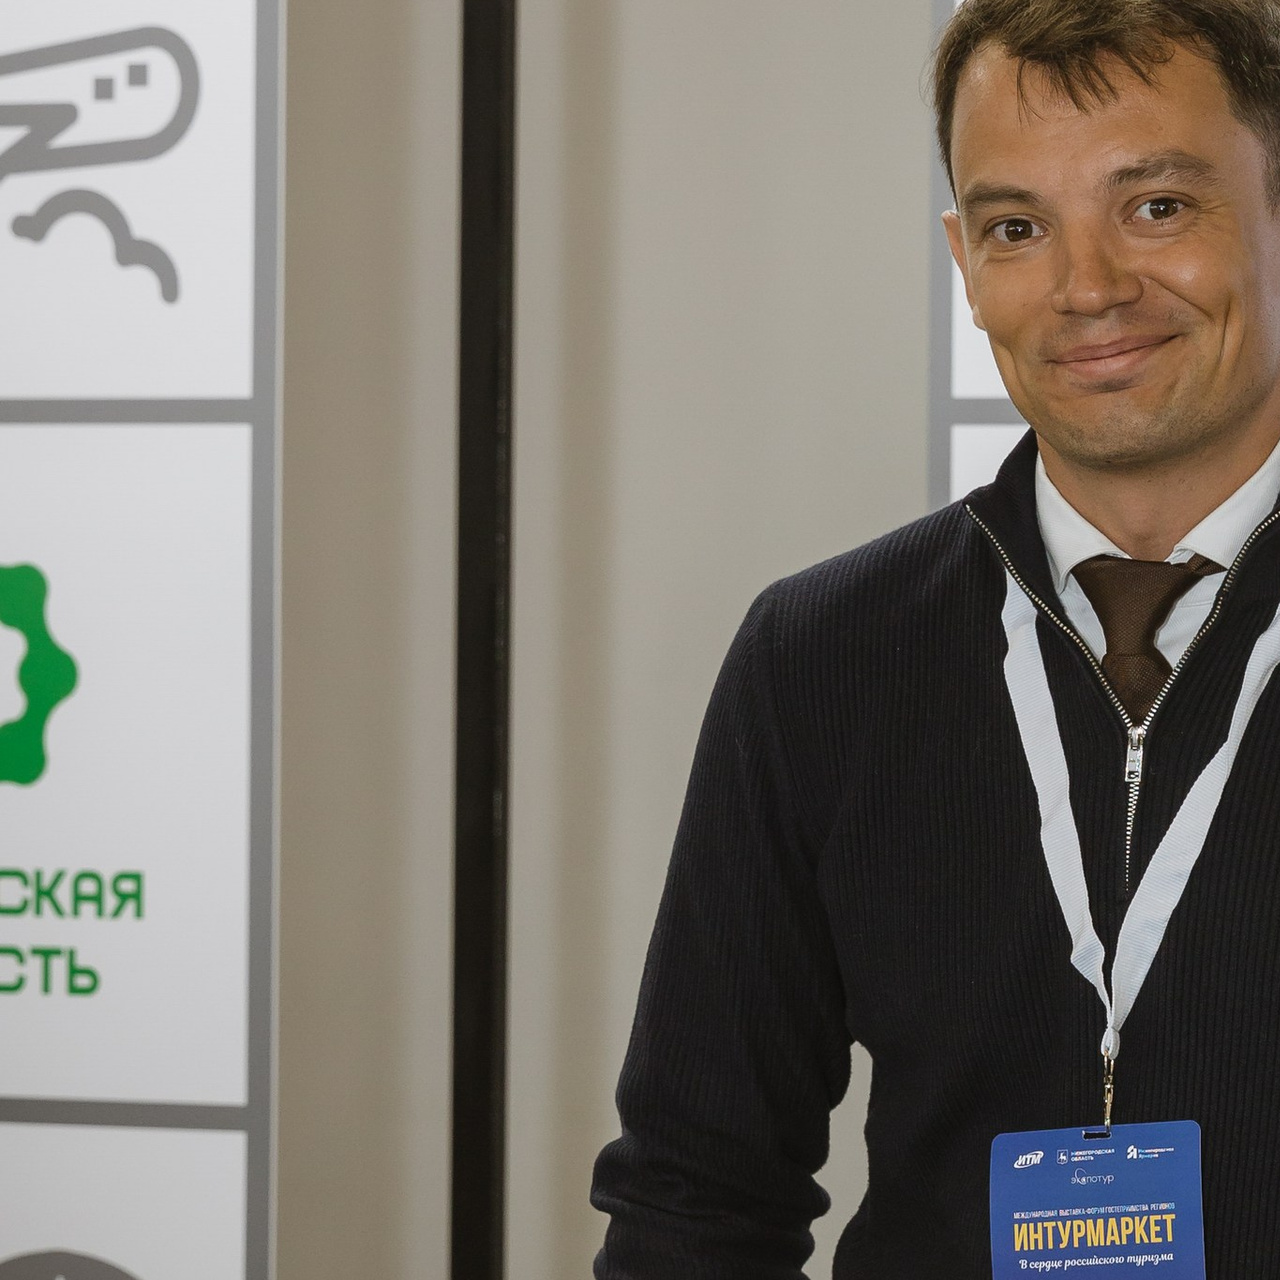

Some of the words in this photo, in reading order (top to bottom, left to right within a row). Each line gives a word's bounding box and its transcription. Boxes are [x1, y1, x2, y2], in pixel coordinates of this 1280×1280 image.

[1016, 1152, 1043, 1167] ИТМ
[1013, 1209, 1058, 1219] МЕЖДУНАРОДНАЯ
[1150, 1202, 1176, 1211] РЕГИОНОВ
[1013, 1213, 1176, 1251] ИНТУРМАРКЕТ
[1019, 1259, 1028, 1269] В
[1029, 1258, 1063, 1272] сердце
[1064, 1252, 1125, 1270] российского
[1126, 1253, 1174, 1267] туризма
